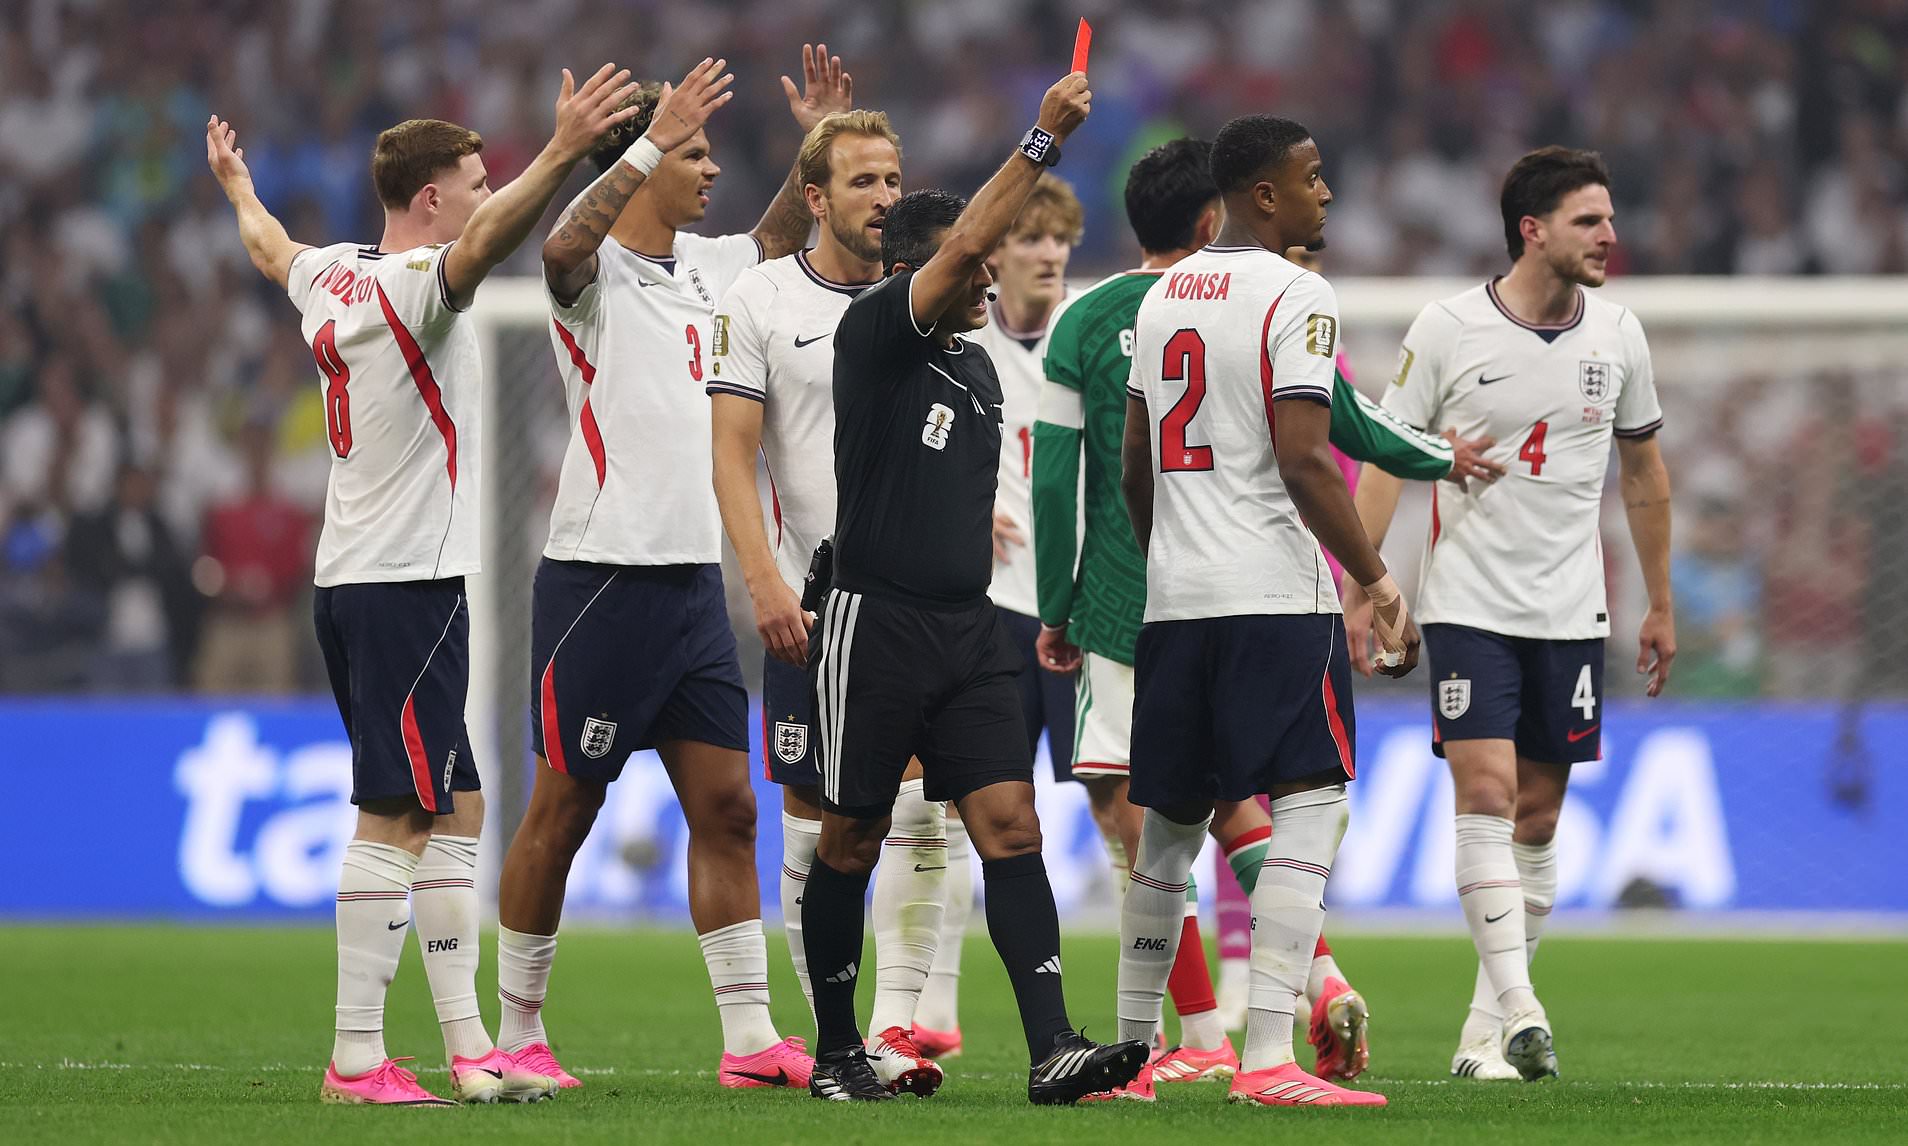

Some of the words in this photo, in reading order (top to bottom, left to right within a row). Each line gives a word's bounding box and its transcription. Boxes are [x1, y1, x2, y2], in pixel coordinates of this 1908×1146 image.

[1165, 272, 1232, 300] KONSA
[686, 324, 703, 381] 3
[313, 319, 352, 459] 8
[1160, 328, 1214, 472] 2
[927, 437, 939, 445] FIFA
[1519, 420, 1548, 476] 4
[1571, 664, 1596, 720] 4
[427, 937, 459, 953] ENG
[1133, 937, 1168, 951] ENG
